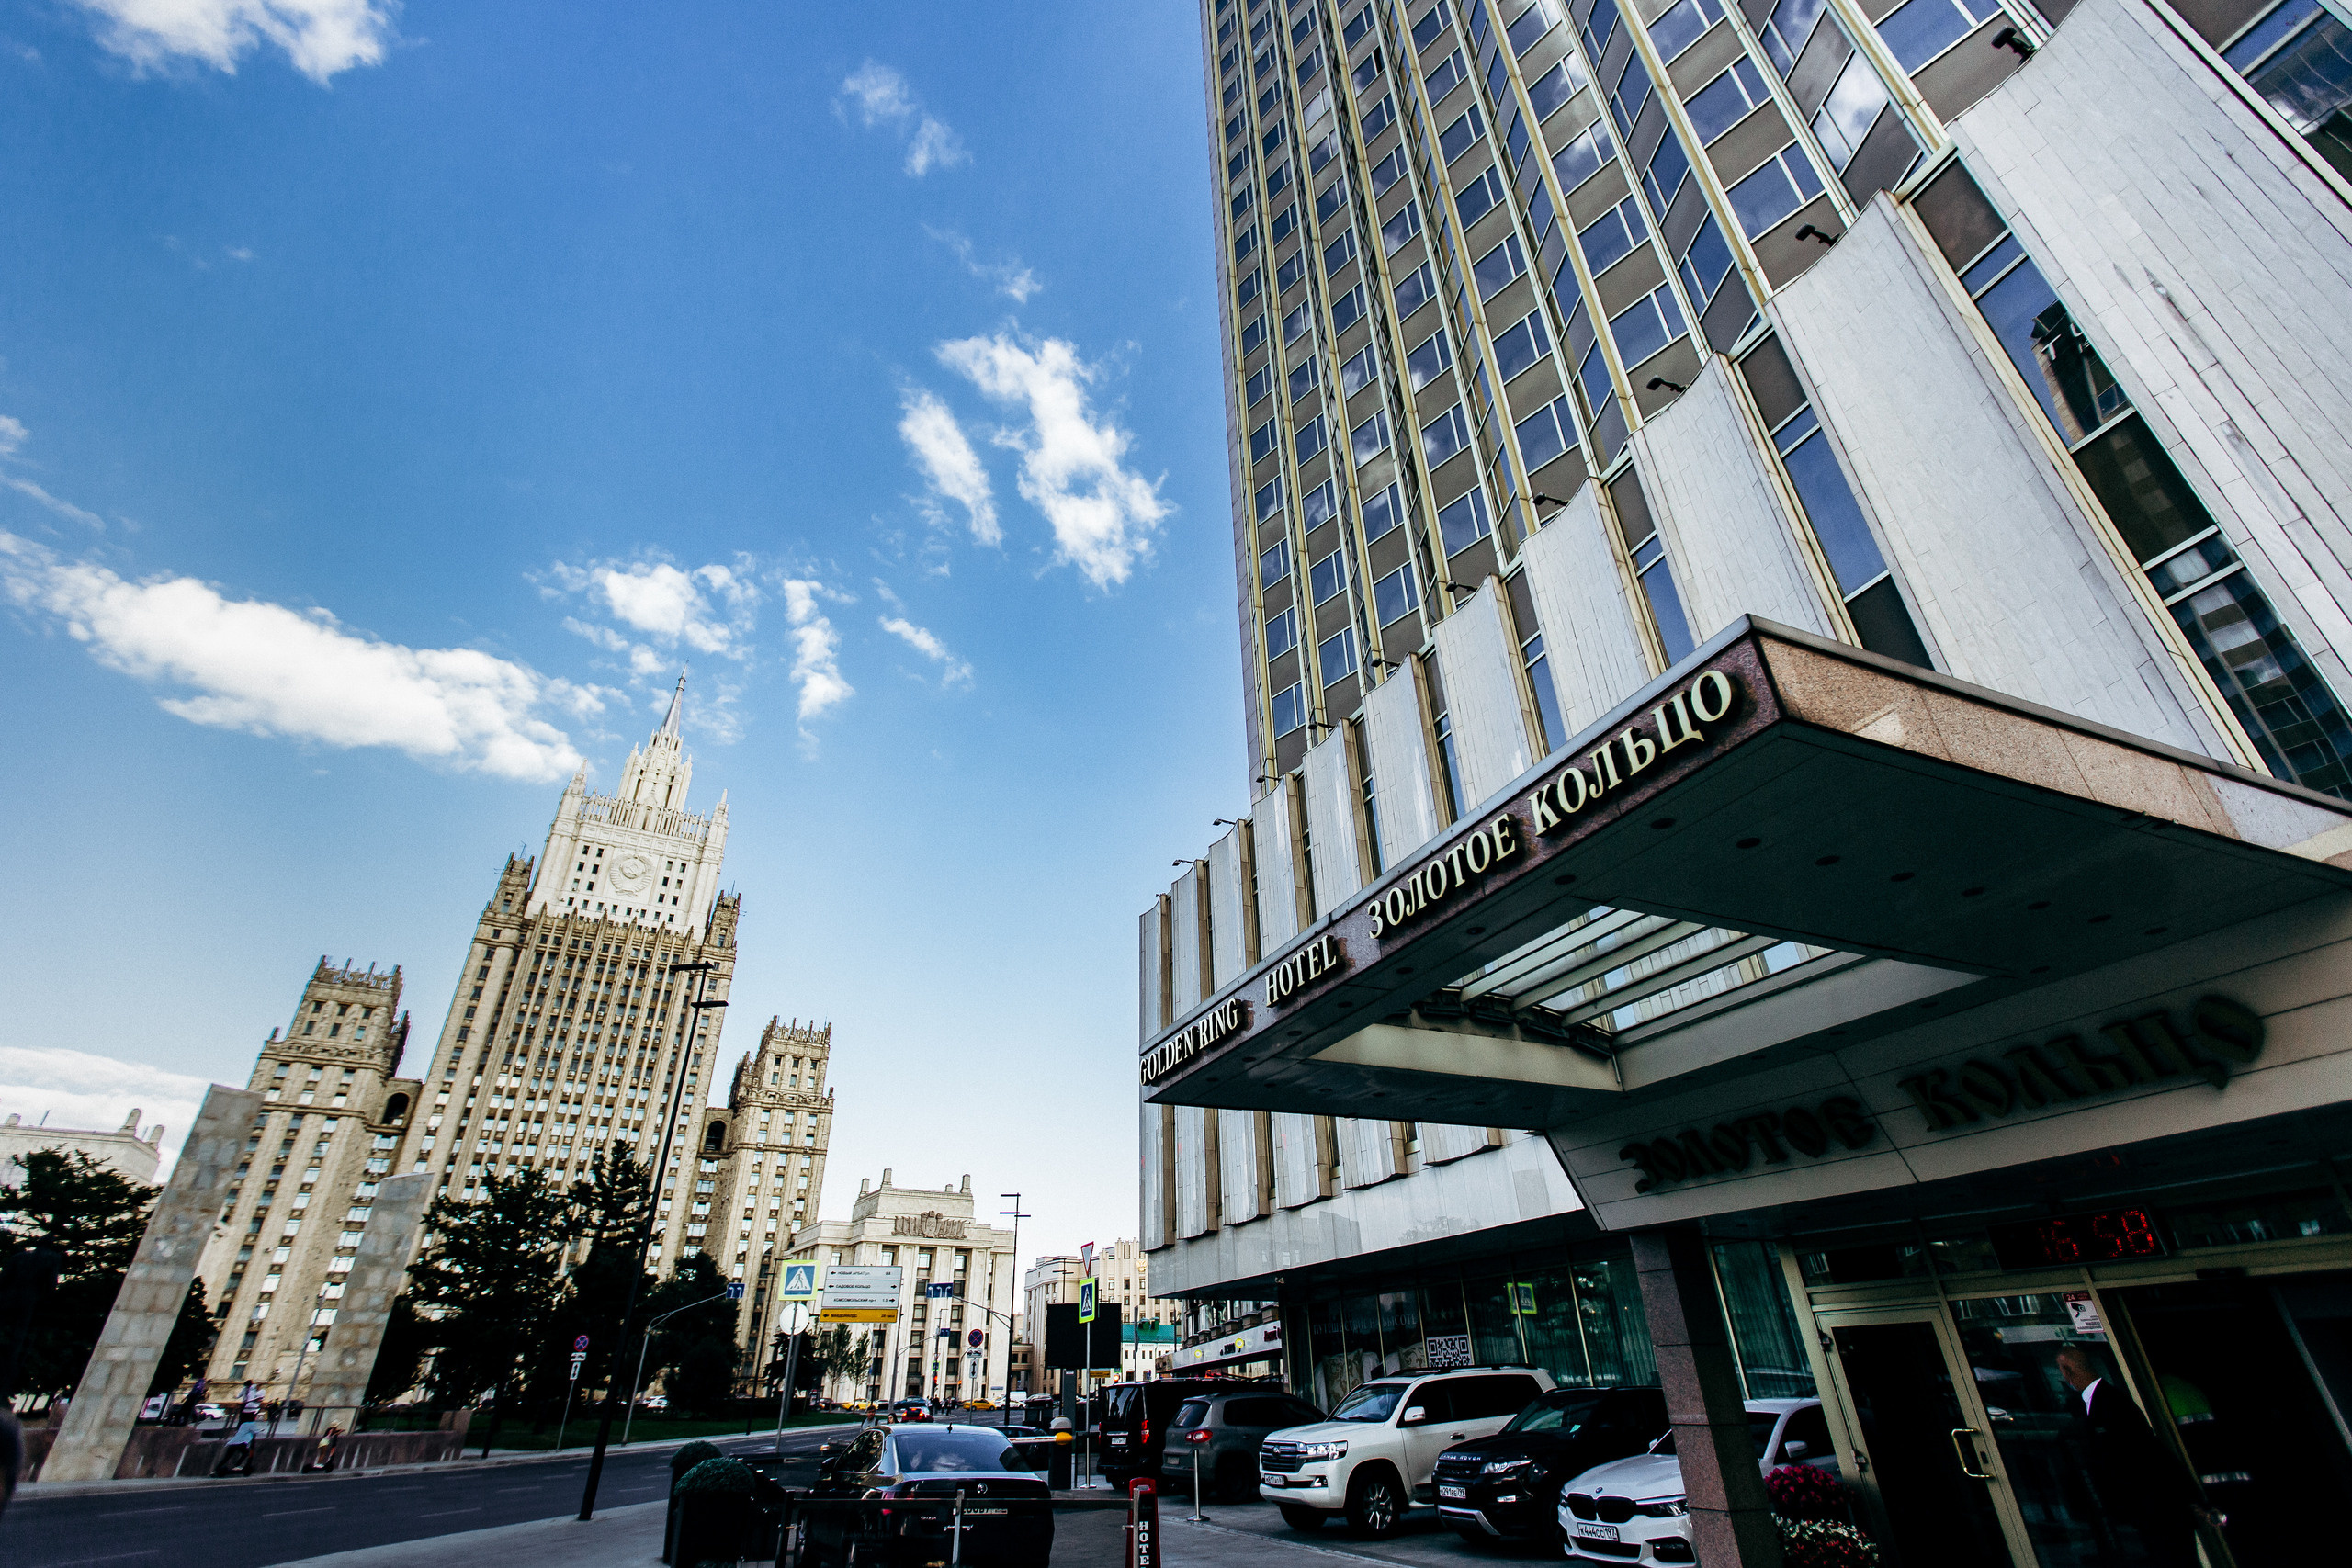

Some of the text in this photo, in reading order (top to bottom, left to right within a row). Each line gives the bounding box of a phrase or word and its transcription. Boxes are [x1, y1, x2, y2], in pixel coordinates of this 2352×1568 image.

[1368, 669, 1734, 939] ЗОЛОТОЕ КОЛЬЦО
[1139, 934, 1338, 1086] GOLDEN RING HOTEL
[1618, 994, 2265, 1195] ЗОЛОТОЕ КОЛЬЦО
[1139, 1521, 1149, 1568] HOTE
